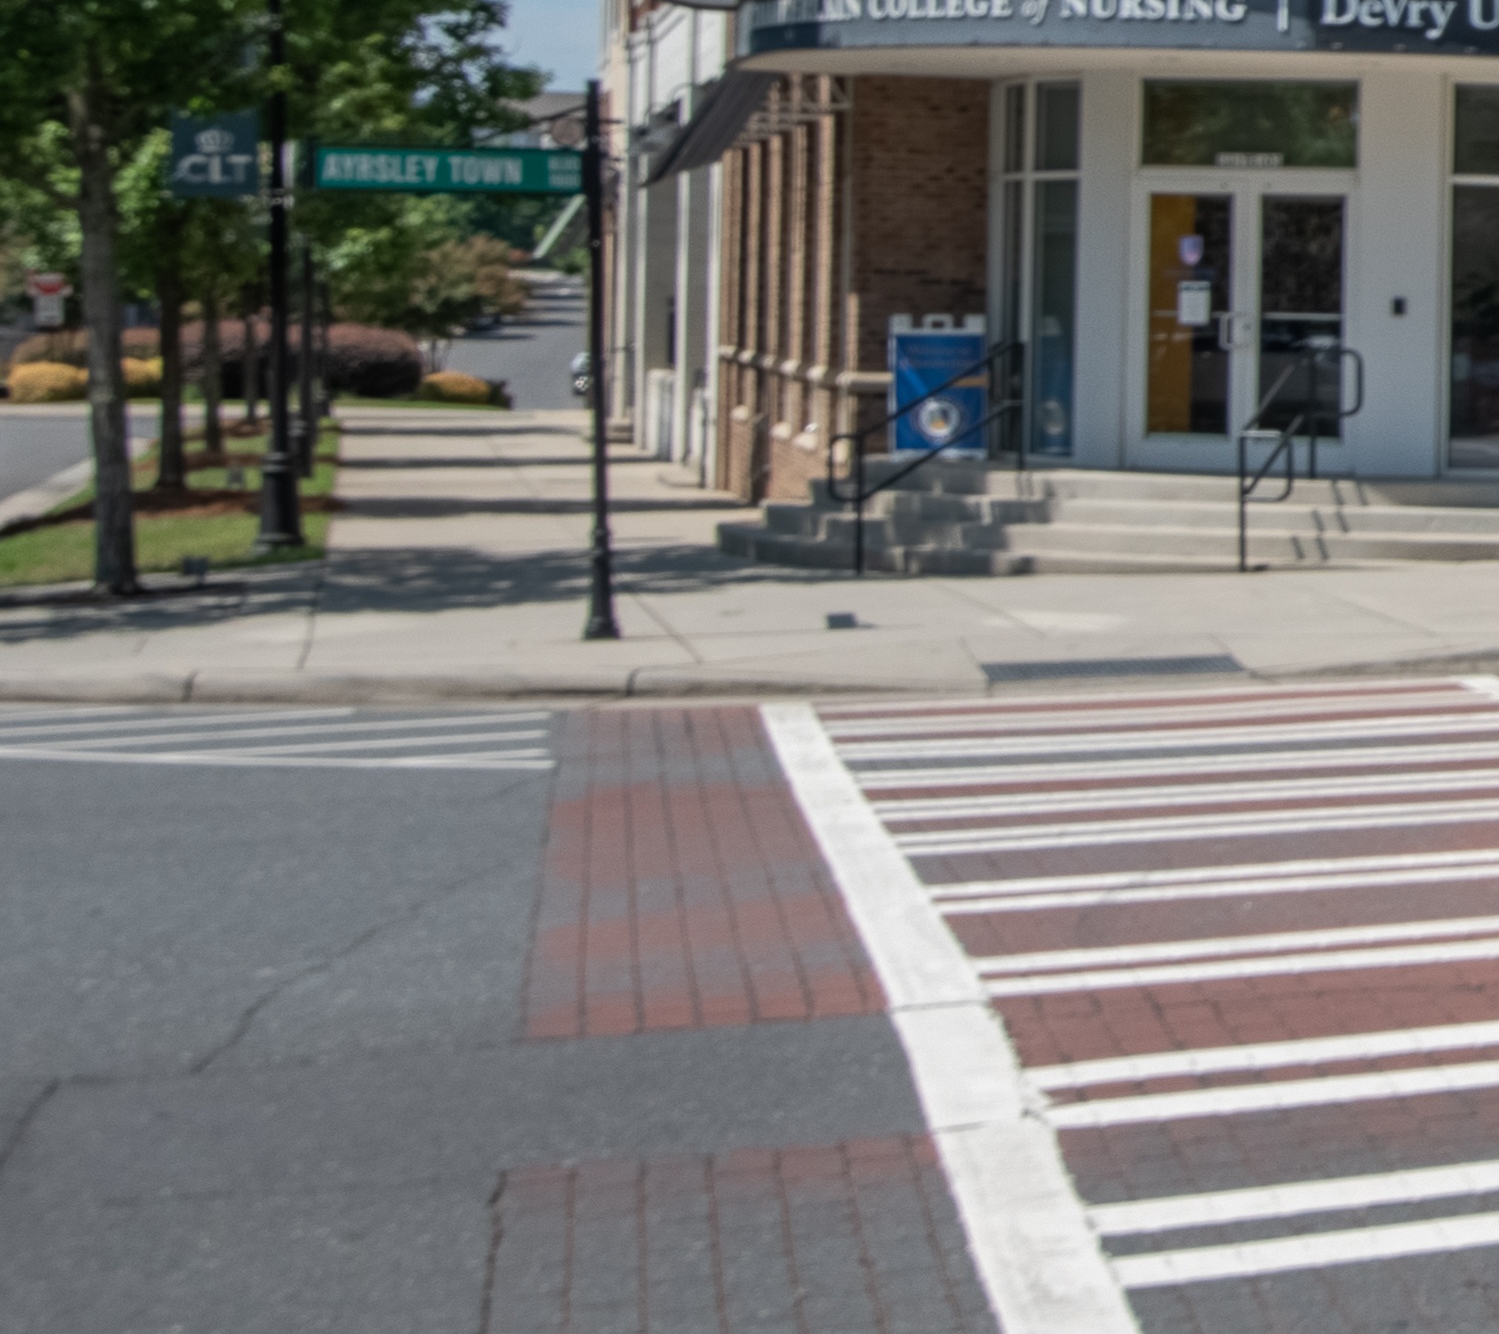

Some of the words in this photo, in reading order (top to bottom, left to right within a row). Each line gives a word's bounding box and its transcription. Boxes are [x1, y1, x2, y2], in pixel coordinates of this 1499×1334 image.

[172, 152, 254, 184] CLT
[321, 152, 441, 184] AYRSLEY
[448, 154, 523, 185] TOWN
